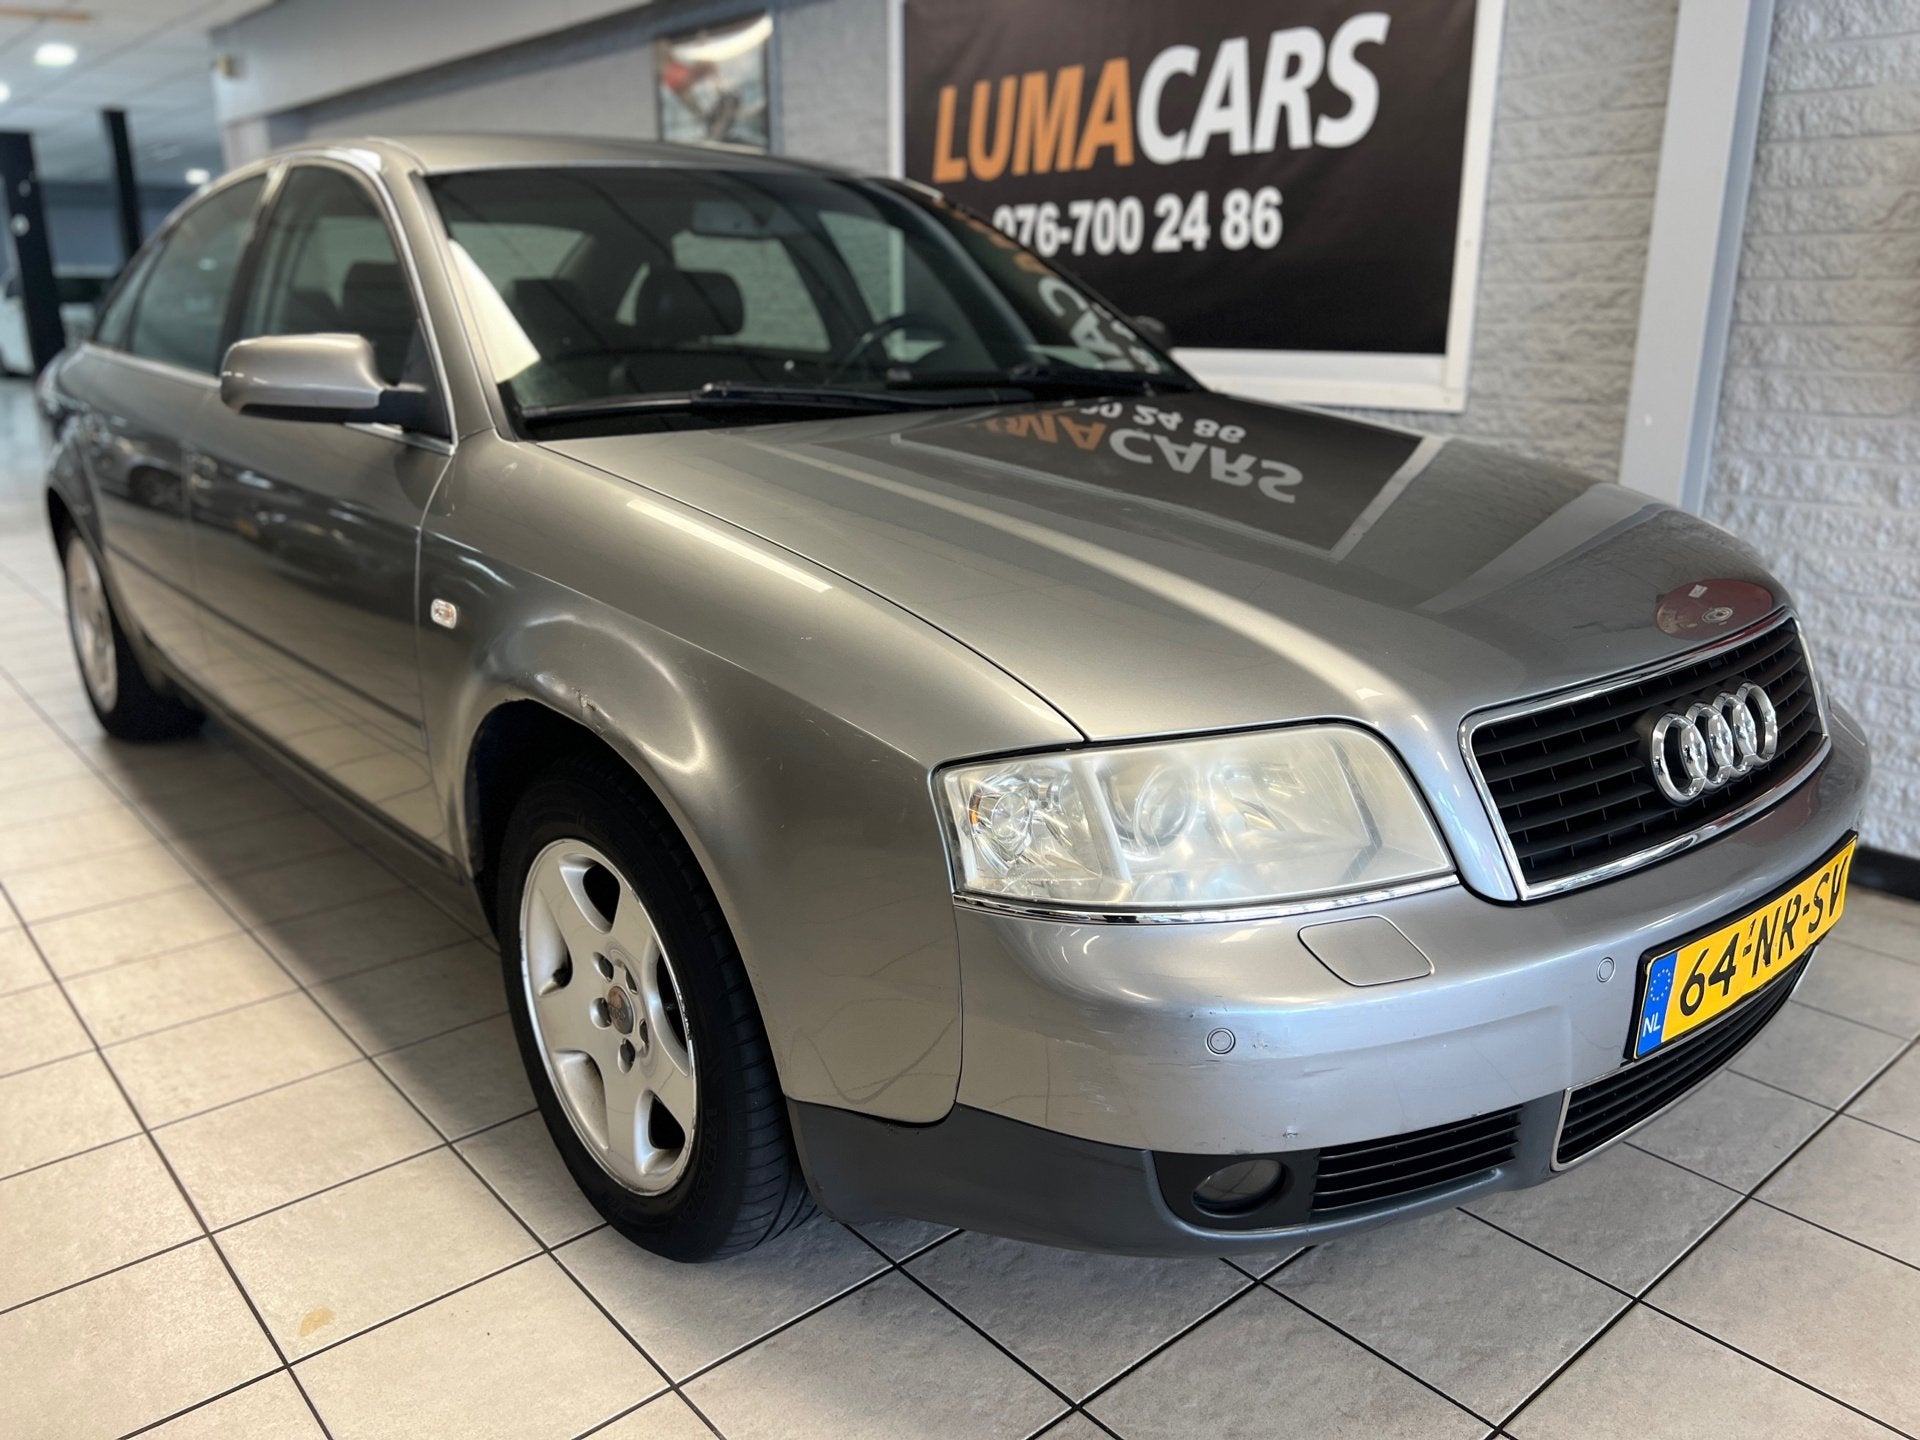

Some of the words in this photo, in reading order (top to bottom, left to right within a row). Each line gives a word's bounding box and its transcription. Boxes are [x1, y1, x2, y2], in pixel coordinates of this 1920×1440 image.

[933, 12, 1391, 183] LUMACARS
[992, 196, 1144, 257] 076-700
[1152, 190, 1211, 253] 24
[1220, 186, 1284, 251] 86
[1679, 855, 1849, 1017] 64-NR-SV
[1642, 1011, 1661, 1038] NL
